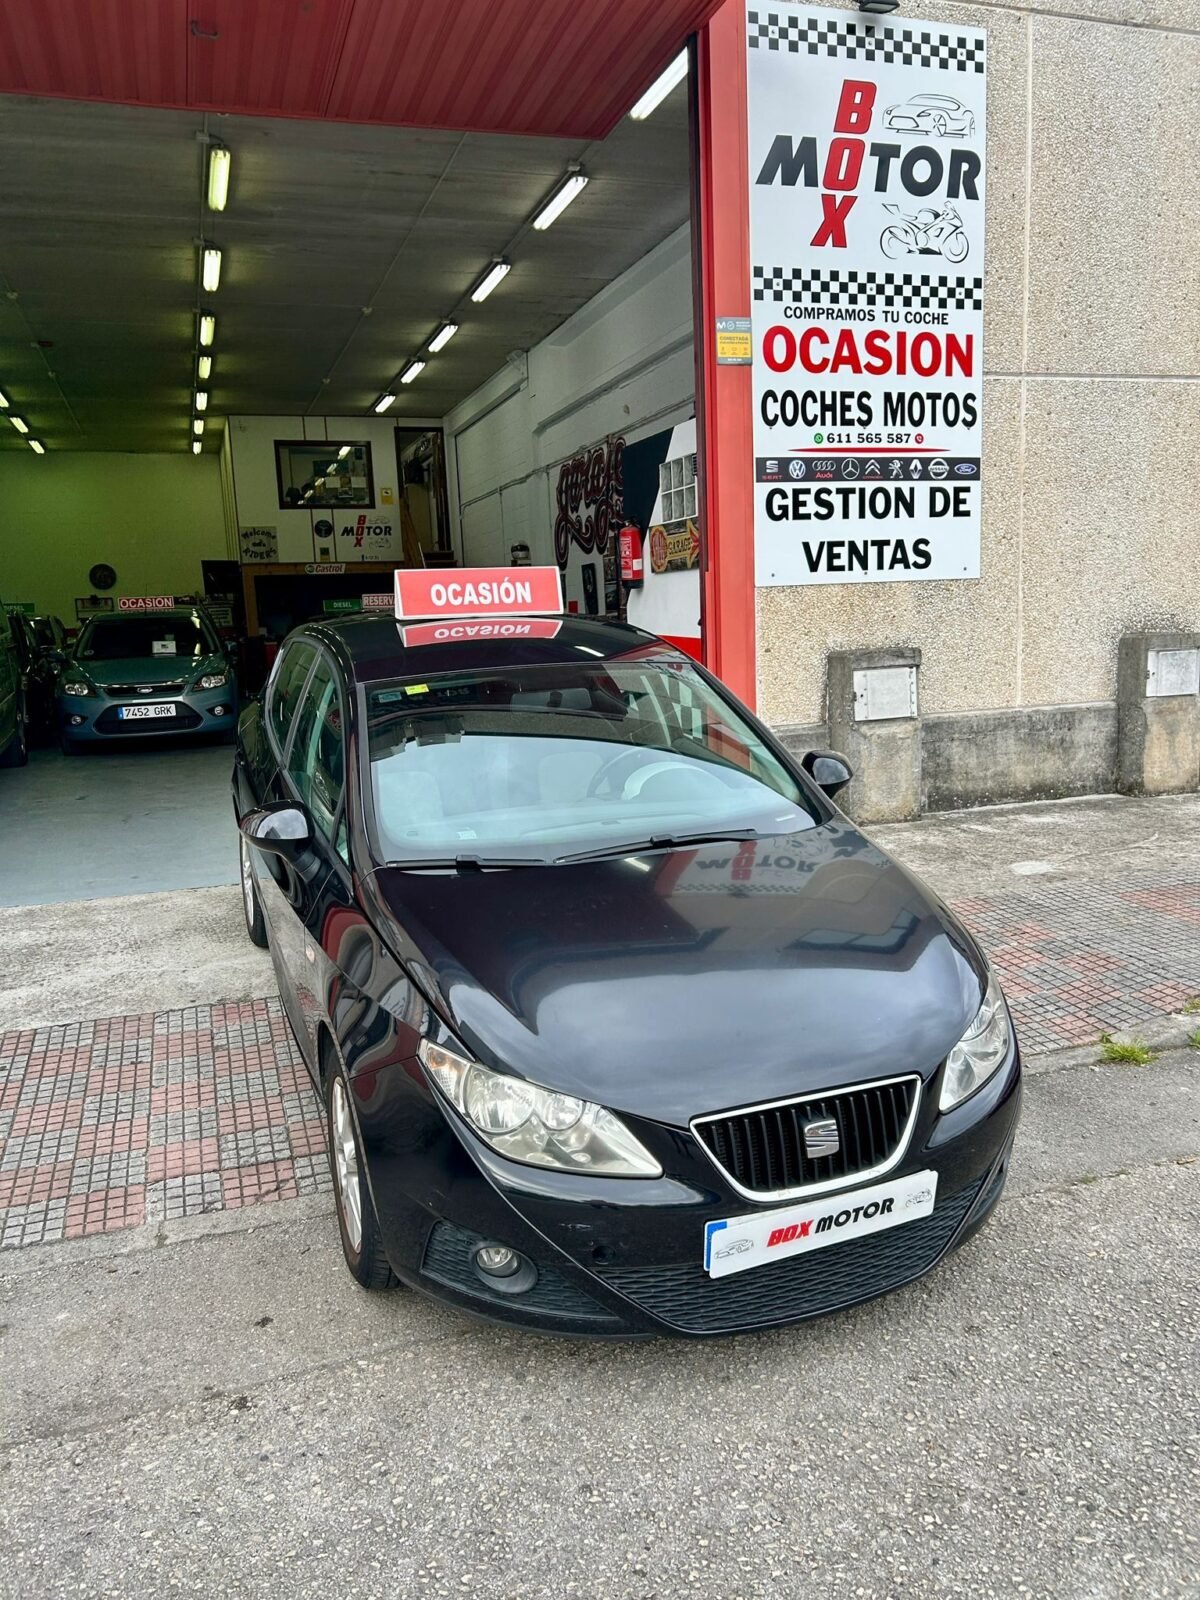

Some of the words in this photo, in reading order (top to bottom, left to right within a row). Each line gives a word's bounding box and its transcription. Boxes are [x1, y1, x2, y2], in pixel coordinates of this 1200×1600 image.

[755, 135, 981, 200] MOTOR
[810, 79, 877, 248] BOX
[784, 306, 876, 323] COMPRAMOS
[882, 311, 900, 324] TU
[905, 311, 949, 325] COCHE
[762, 325, 974, 378] OCASION
[761, 389, 873, 428] COCHES
[883, 391, 977, 428] MOTOS
[827, 433, 851, 444] 611
[857, 433, 882, 444] 565
[886, 433, 911, 444] 587
[765, 486, 915, 521] GESTION
[929, 486, 971, 518] DE
[341, 526, 392, 536] MOTOR
[316, 565, 343, 573] Castrol
[802, 538, 932, 573] VENTAS
[120, 599, 173, 609] OCASION
[364, 594, 395, 605] RESERV
[430, 577, 533, 606] OCASIÓN
[125, 707, 149, 718] 7452
[154, 706, 173, 716] GRK
[767, 1219, 814, 1247] BOX
[815, 1198, 895, 1234] MOTOR
